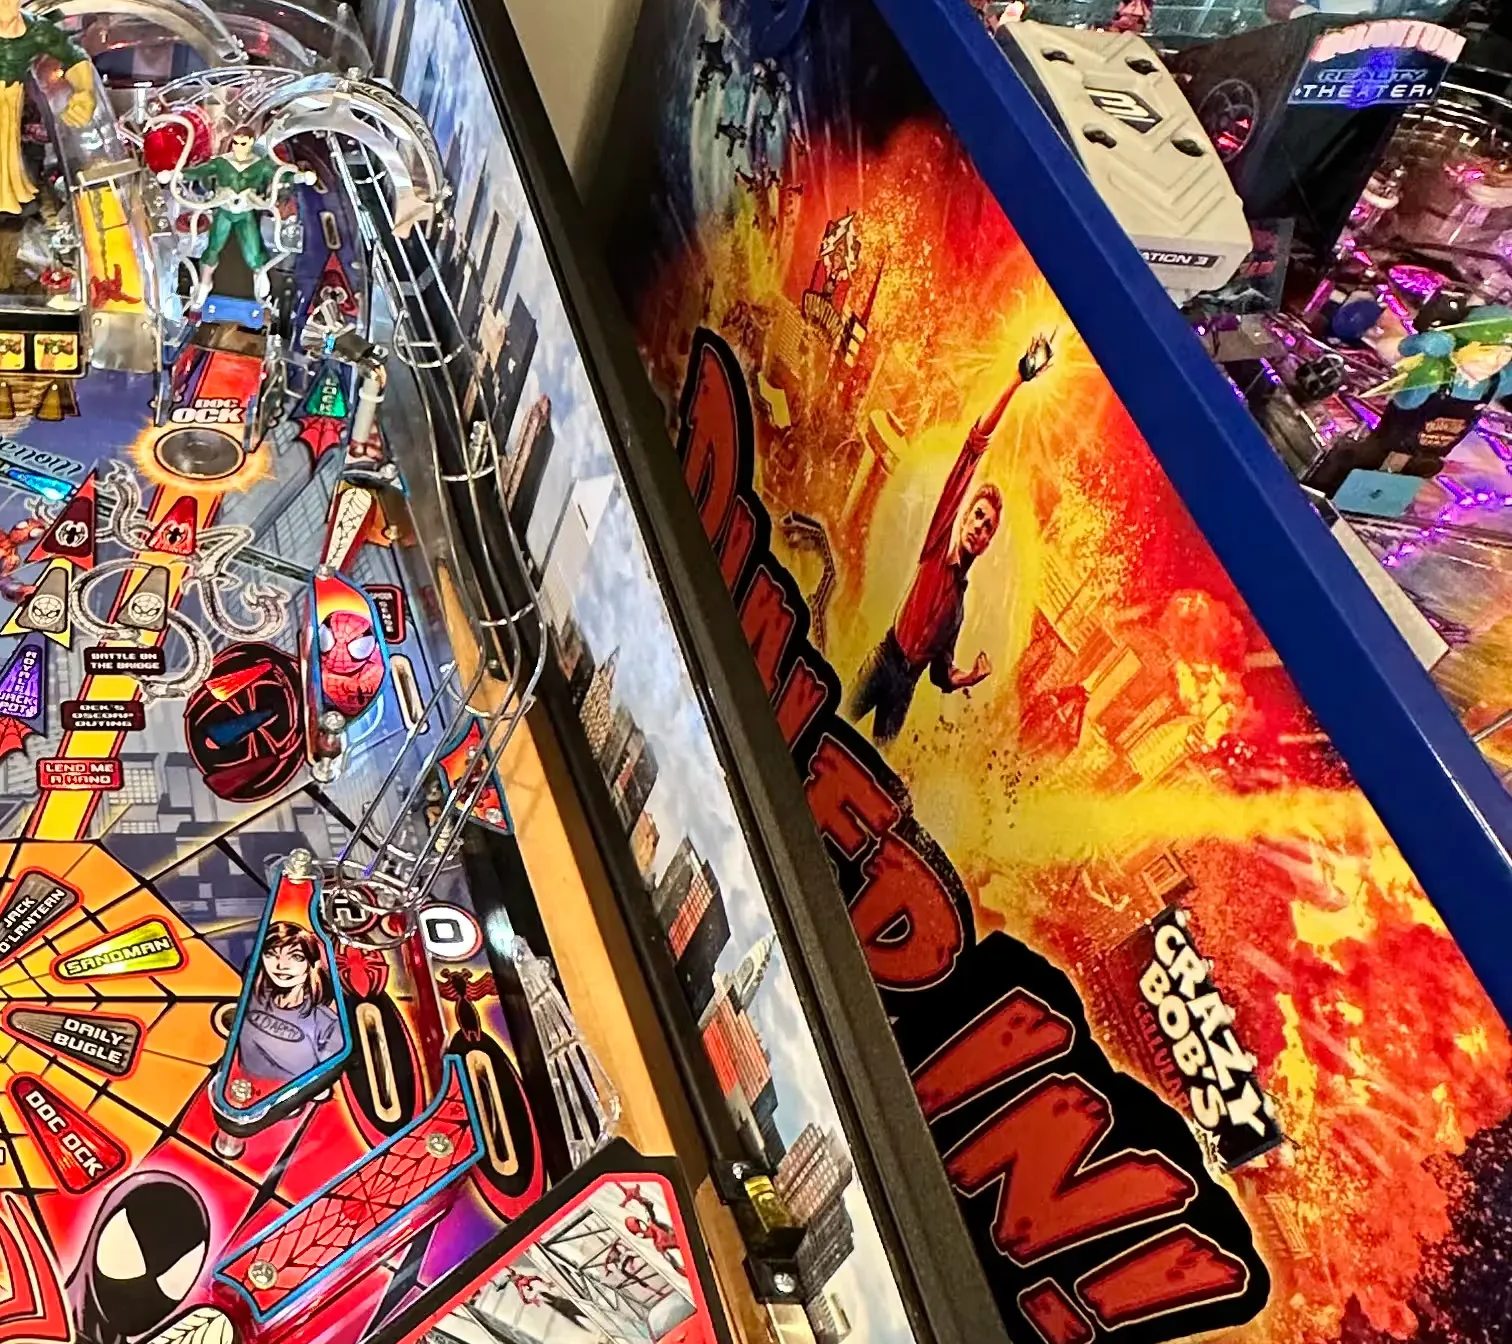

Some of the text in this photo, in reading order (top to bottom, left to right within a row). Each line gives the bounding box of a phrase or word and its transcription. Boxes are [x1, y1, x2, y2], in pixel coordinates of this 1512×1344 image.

[1318, 69, 1428, 82] REALITY
[1303, 84, 1426, 98] THEATER
[195, 399, 231, 408] DOC
[172, 408, 242, 424] OCK
[91, 652, 135, 660] BATTLE
[90, 661, 160, 670] THE BRIDGE
[45, 763, 114, 773] LEND ME
[51, 775, 111, 784] A HAND
[4, 896, 37, 929] JACK
[65, 937, 171, 976] SANDMAN
[63, 1017, 125, 1046] DAILY
[1155, 924, 1265, 1137] CRAZY
[52, 1032, 123, 1064] BUGLE
[1139, 960, 1227, 1128] BOB'S
[25, 1090, 105, 1179] DOC OCK
